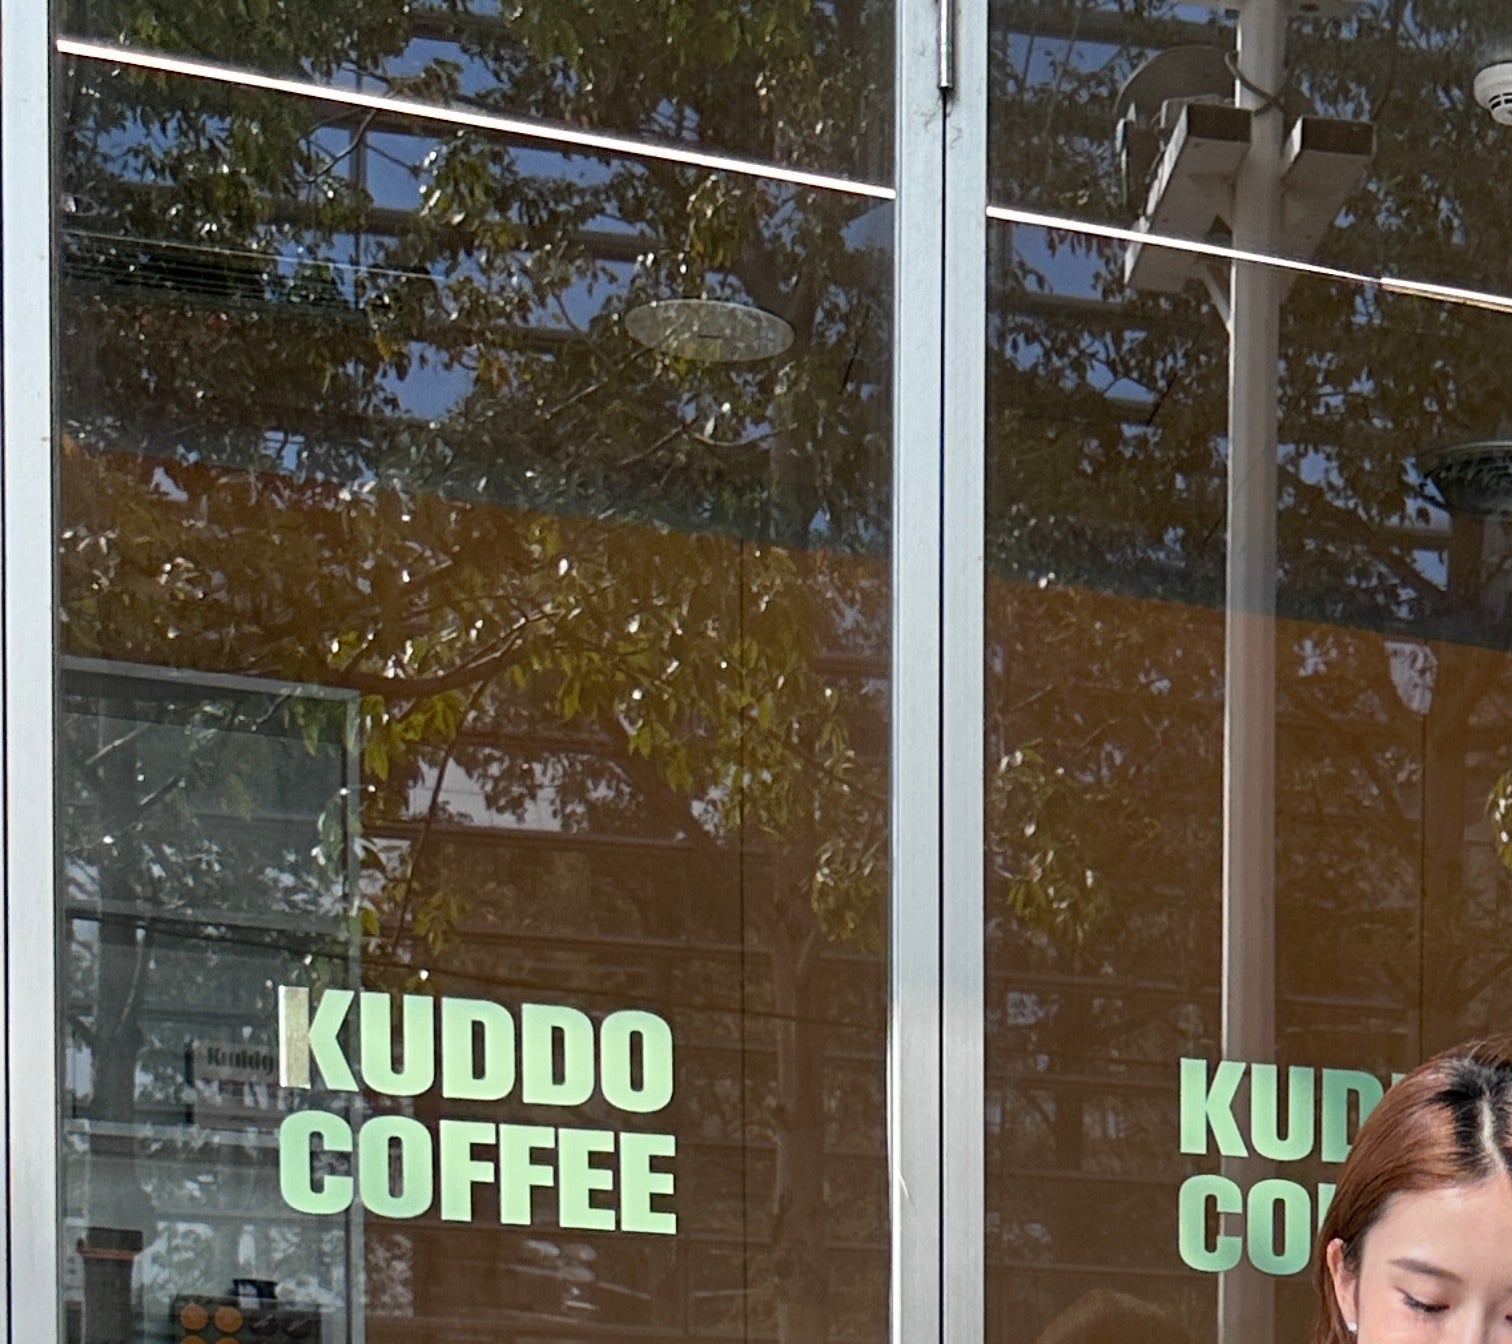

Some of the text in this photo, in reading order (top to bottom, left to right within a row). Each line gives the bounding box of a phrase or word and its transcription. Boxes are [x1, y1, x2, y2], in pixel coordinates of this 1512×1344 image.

[278, 985, 673, 1113] KUDDO
[1180, 1057, 1406, 1162] KUD
[279, 1110, 676, 1235] COFFEE
[1179, 1174, 1337, 1276] CO
